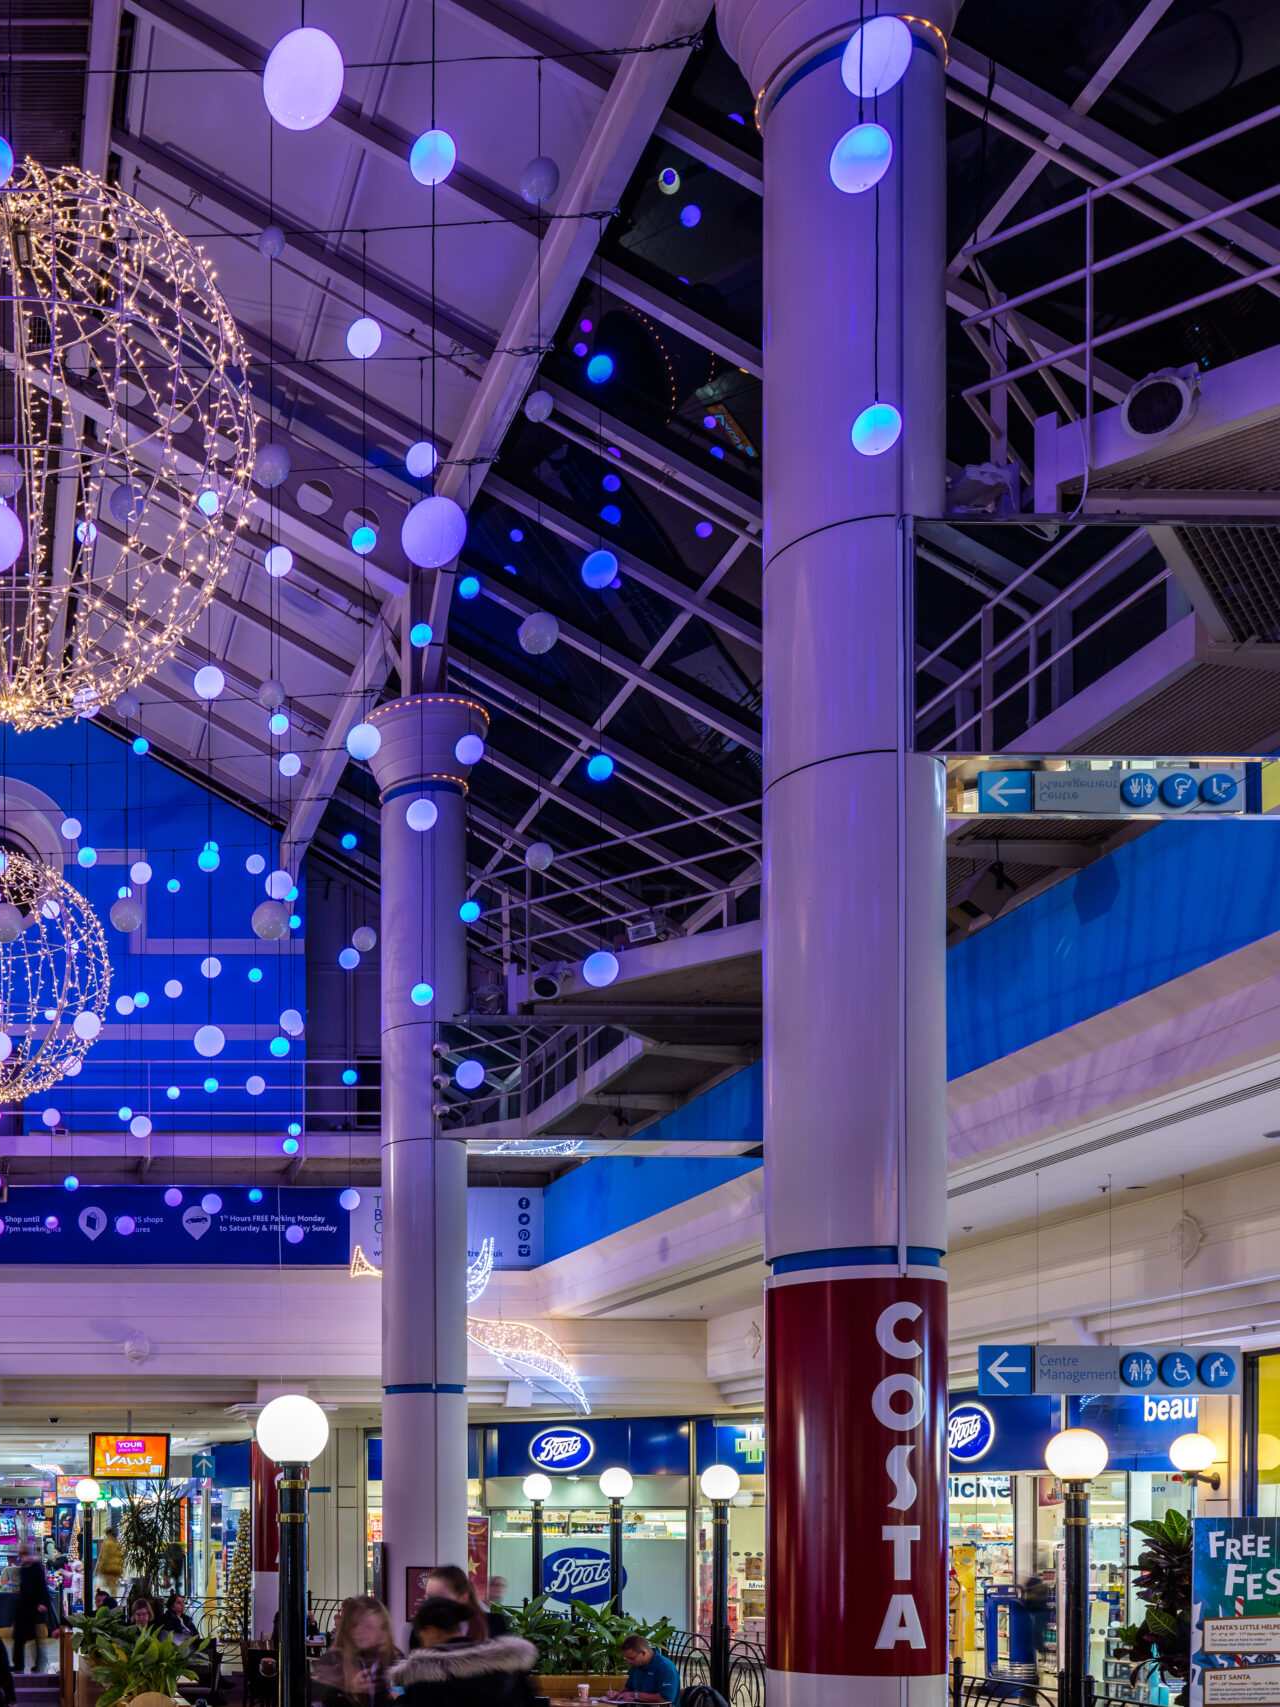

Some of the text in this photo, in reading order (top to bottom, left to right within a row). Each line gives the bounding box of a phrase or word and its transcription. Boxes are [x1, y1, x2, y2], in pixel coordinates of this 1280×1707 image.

[4, 1215, 40, 1224] Shop until
[144, 1216, 163, 1225] shops
[270, 1215, 296, 1224] Parking
[297, 1215, 326, 1224] Monday
[5, 1226, 21, 1234] 7pm
[229, 1224, 260, 1234] Saturday
[311, 1224, 338, 1234] Sunday
[1039, 1355, 1079, 1367] Centre
[1039, 1367, 1118, 1382] Management
[536, 1435, 582, 1462] Boots
[105, 1452, 153, 1466] VALUE
[872, 1301, 927, 1650] COSTA
[948, 1476, 1012, 1499] icine
[1208, 1530, 1271, 1560] FREE
[545, 1557, 611, 1594] Boots
